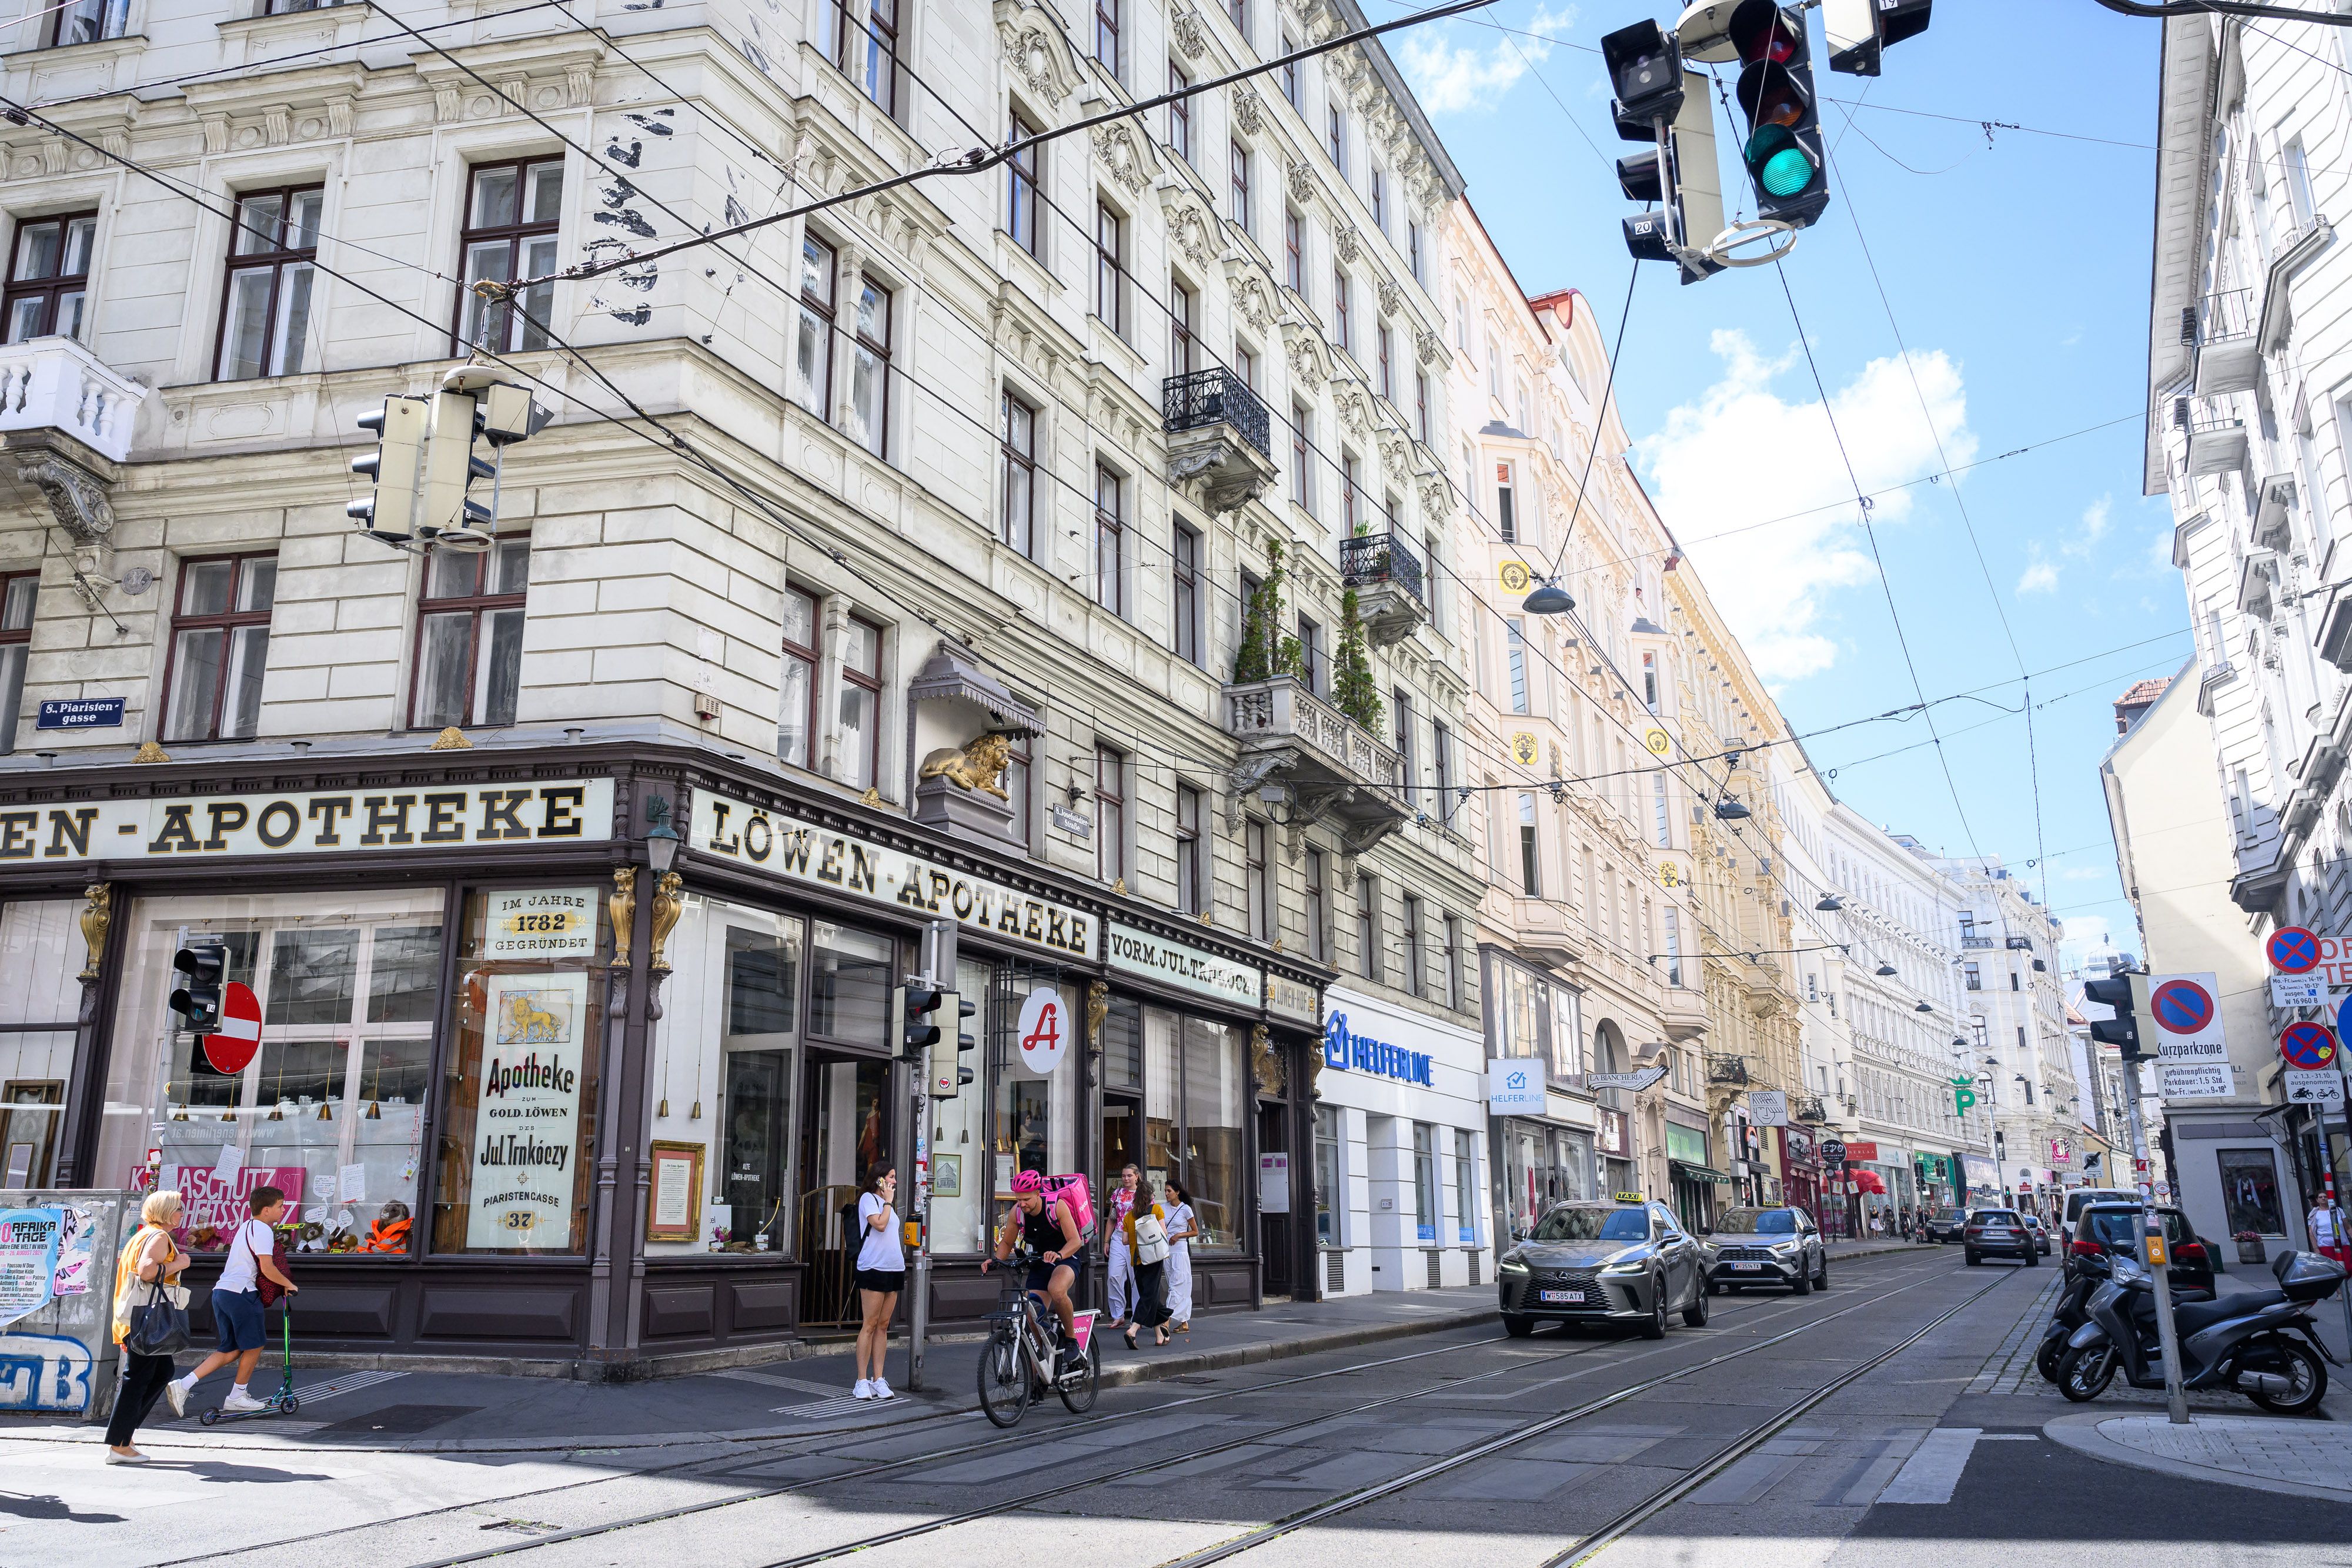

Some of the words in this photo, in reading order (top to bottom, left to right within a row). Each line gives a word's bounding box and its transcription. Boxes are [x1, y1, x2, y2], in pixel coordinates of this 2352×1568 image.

[1636, 223, 1650, 233] 20
[536, 404, 544, 415] 15
[467, 510, 471, 518] 2
[59, 702, 120, 714] Piaristen-
[62, 713, 96, 725] gasse
[1064, 819, 1080, 831] Straße
[502, 898, 522, 911] IM
[527, 895, 585, 910] JAHRE
[517, 914, 566, 932] 1782
[495, 937, 587, 951] GEGRÜNDET
[1277, 980, 1307, 1012] LÖWEN-HOF
[1352, 1034, 1435, 1087] HELFERLINE
[486, 1052, 574, 1098] Apotheke
[2165, 1066, 2221, 1077] gebührenpflichtig
[1601, 1074, 1643, 1082] BIANCHERIA
[1491, 1094, 1544, 1102] HELFERLINE
[1823, 1144, 1844, 1153] EDO
[731, 1172, 760, 1182] LÖWEN-APOTHEKE
[483, 1191, 559, 1208] PIARISTENGASSE
[509, 1212, 532, 1228] 37
[0, 1222, 14, 1243] 0.
[12, 1221, 56, 1232] AFRIKA
[15, 1232, 47, 1243] TAGE
[1029, 1332, 1040, 1353] CYCLE
